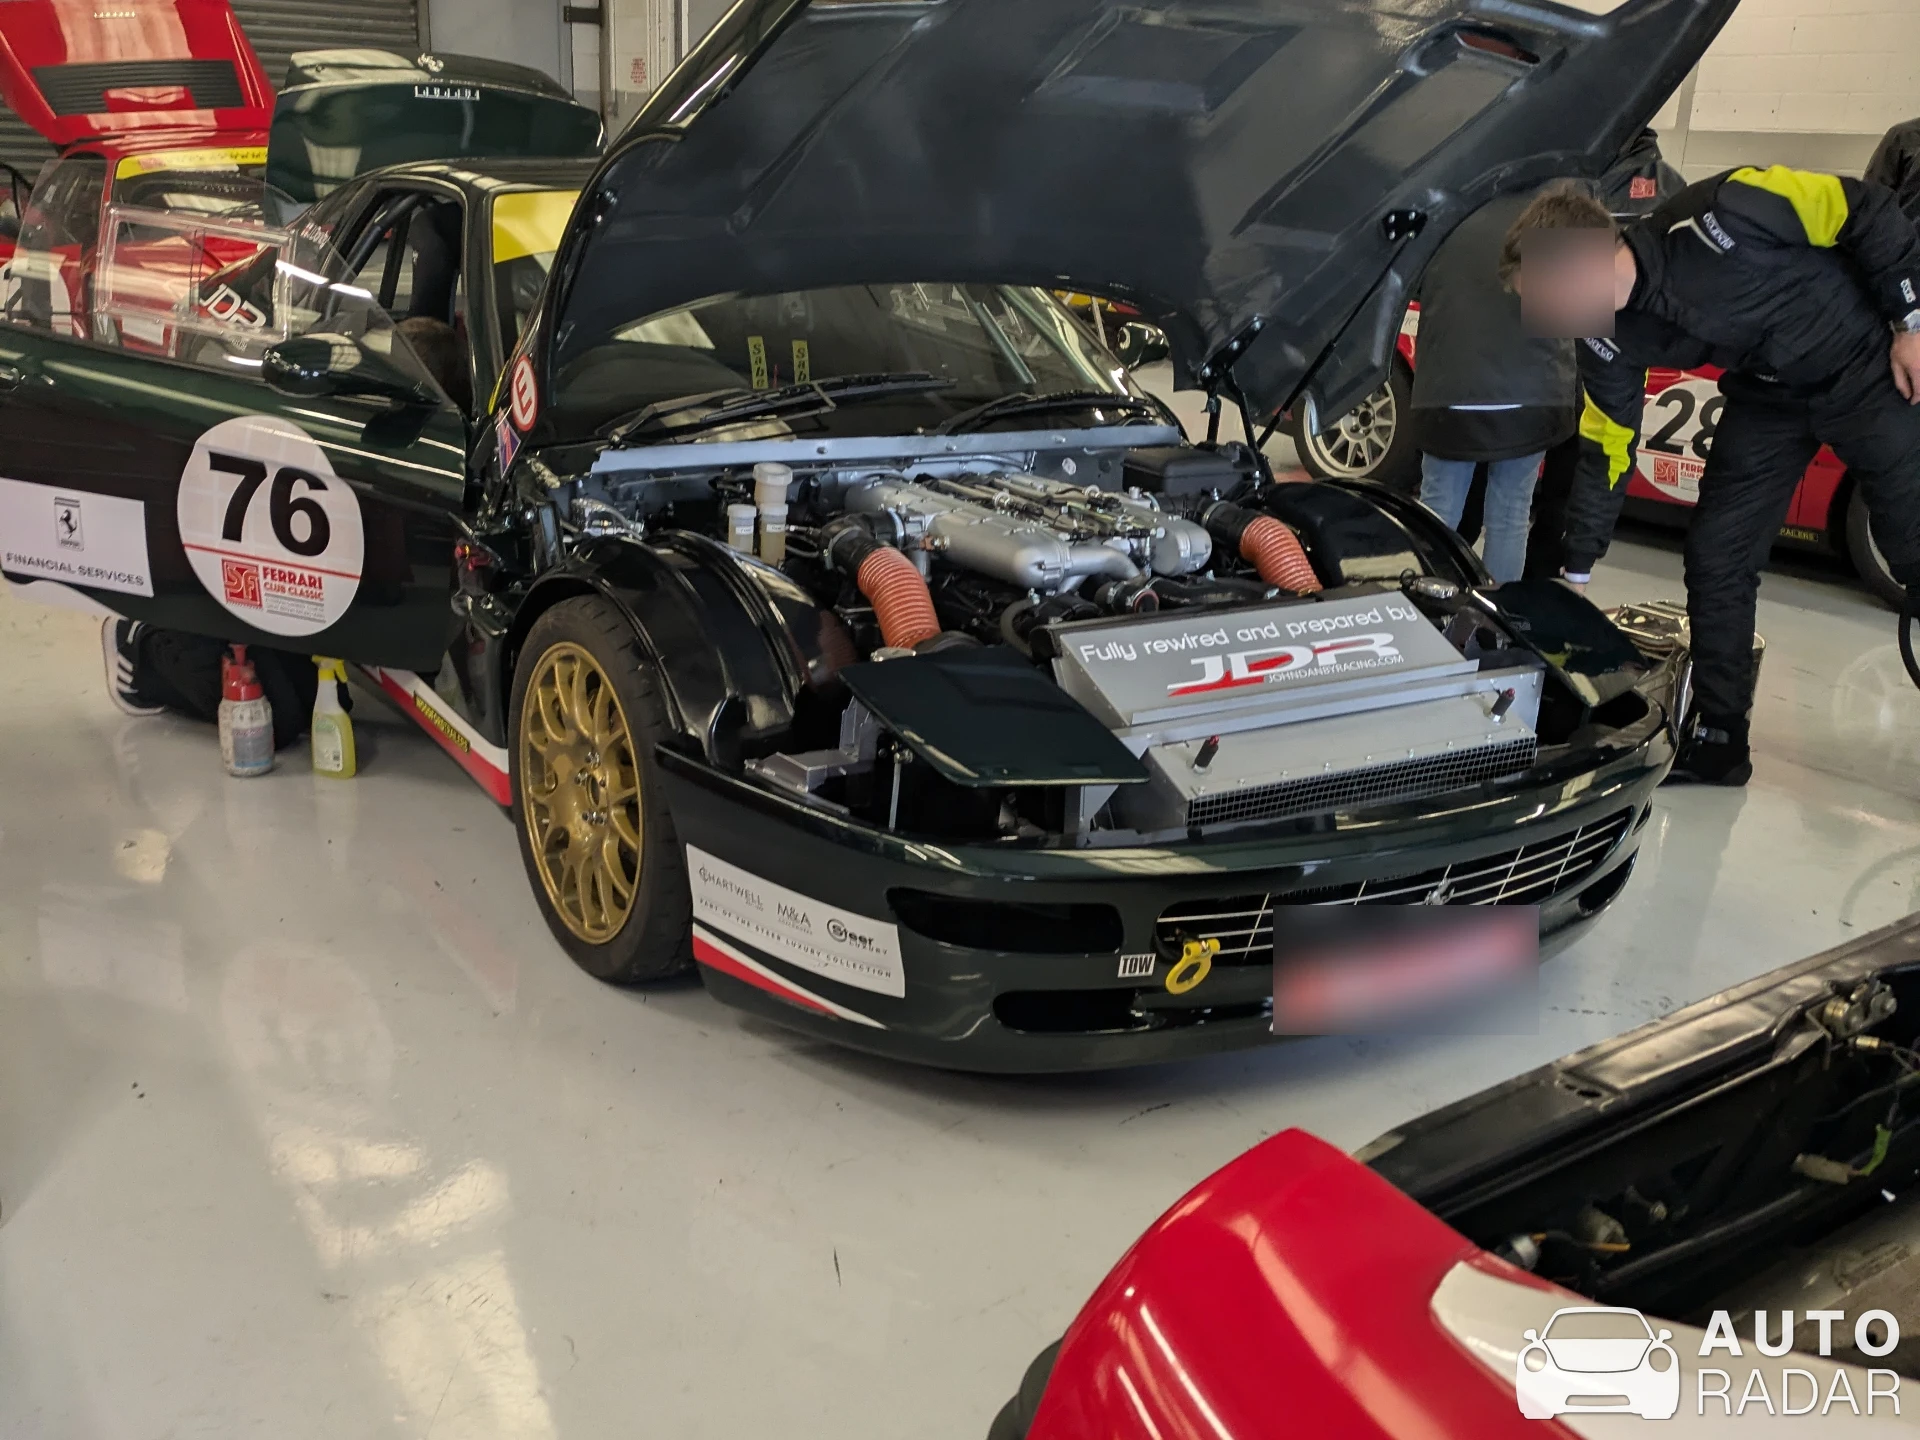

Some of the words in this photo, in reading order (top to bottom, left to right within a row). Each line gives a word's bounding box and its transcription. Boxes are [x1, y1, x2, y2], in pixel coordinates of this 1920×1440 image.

[1584, 337, 1614, 362] parco
[515, 367, 532, 418] E
[1645, 388, 1728, 459] 28
[1680, 462, 1704, 474] FERR
[208, 451, 330, 557] 76
[6, 551, 77, 575] FINANCIAL
[78, 564, 145, 587] SERVICES
[262, 565, 323, 590] FERRARI
[264, 581, 286, 594] CLUB
[288, 586, 325, 602] CLASSIC
[1080, 641, 1137, 663] Fully
[1143, 628, 1230, 655] rewired
[1236, 621, 1280, 643] and
[1286, 607, 1383, 639] prepared
[1386, 604, 1418, 622] by
[1167, 632, 1400, 691] JDR
[1268, 654, 1405, 684] JOHNDANBYRACING.COM
[699, 866, 763, 907] CHARTWELL
[777, 902, 812, 929] M&A
[700, 897, 718, 912] PART
[736, 915, 750, 927] THE
[755, 924, 781, 940] STEER
[786, 938, 821, 957] LUXURY
[826, 953, 891, 979] COLLECTION
[1121, 956, 1153, 975] TOW
